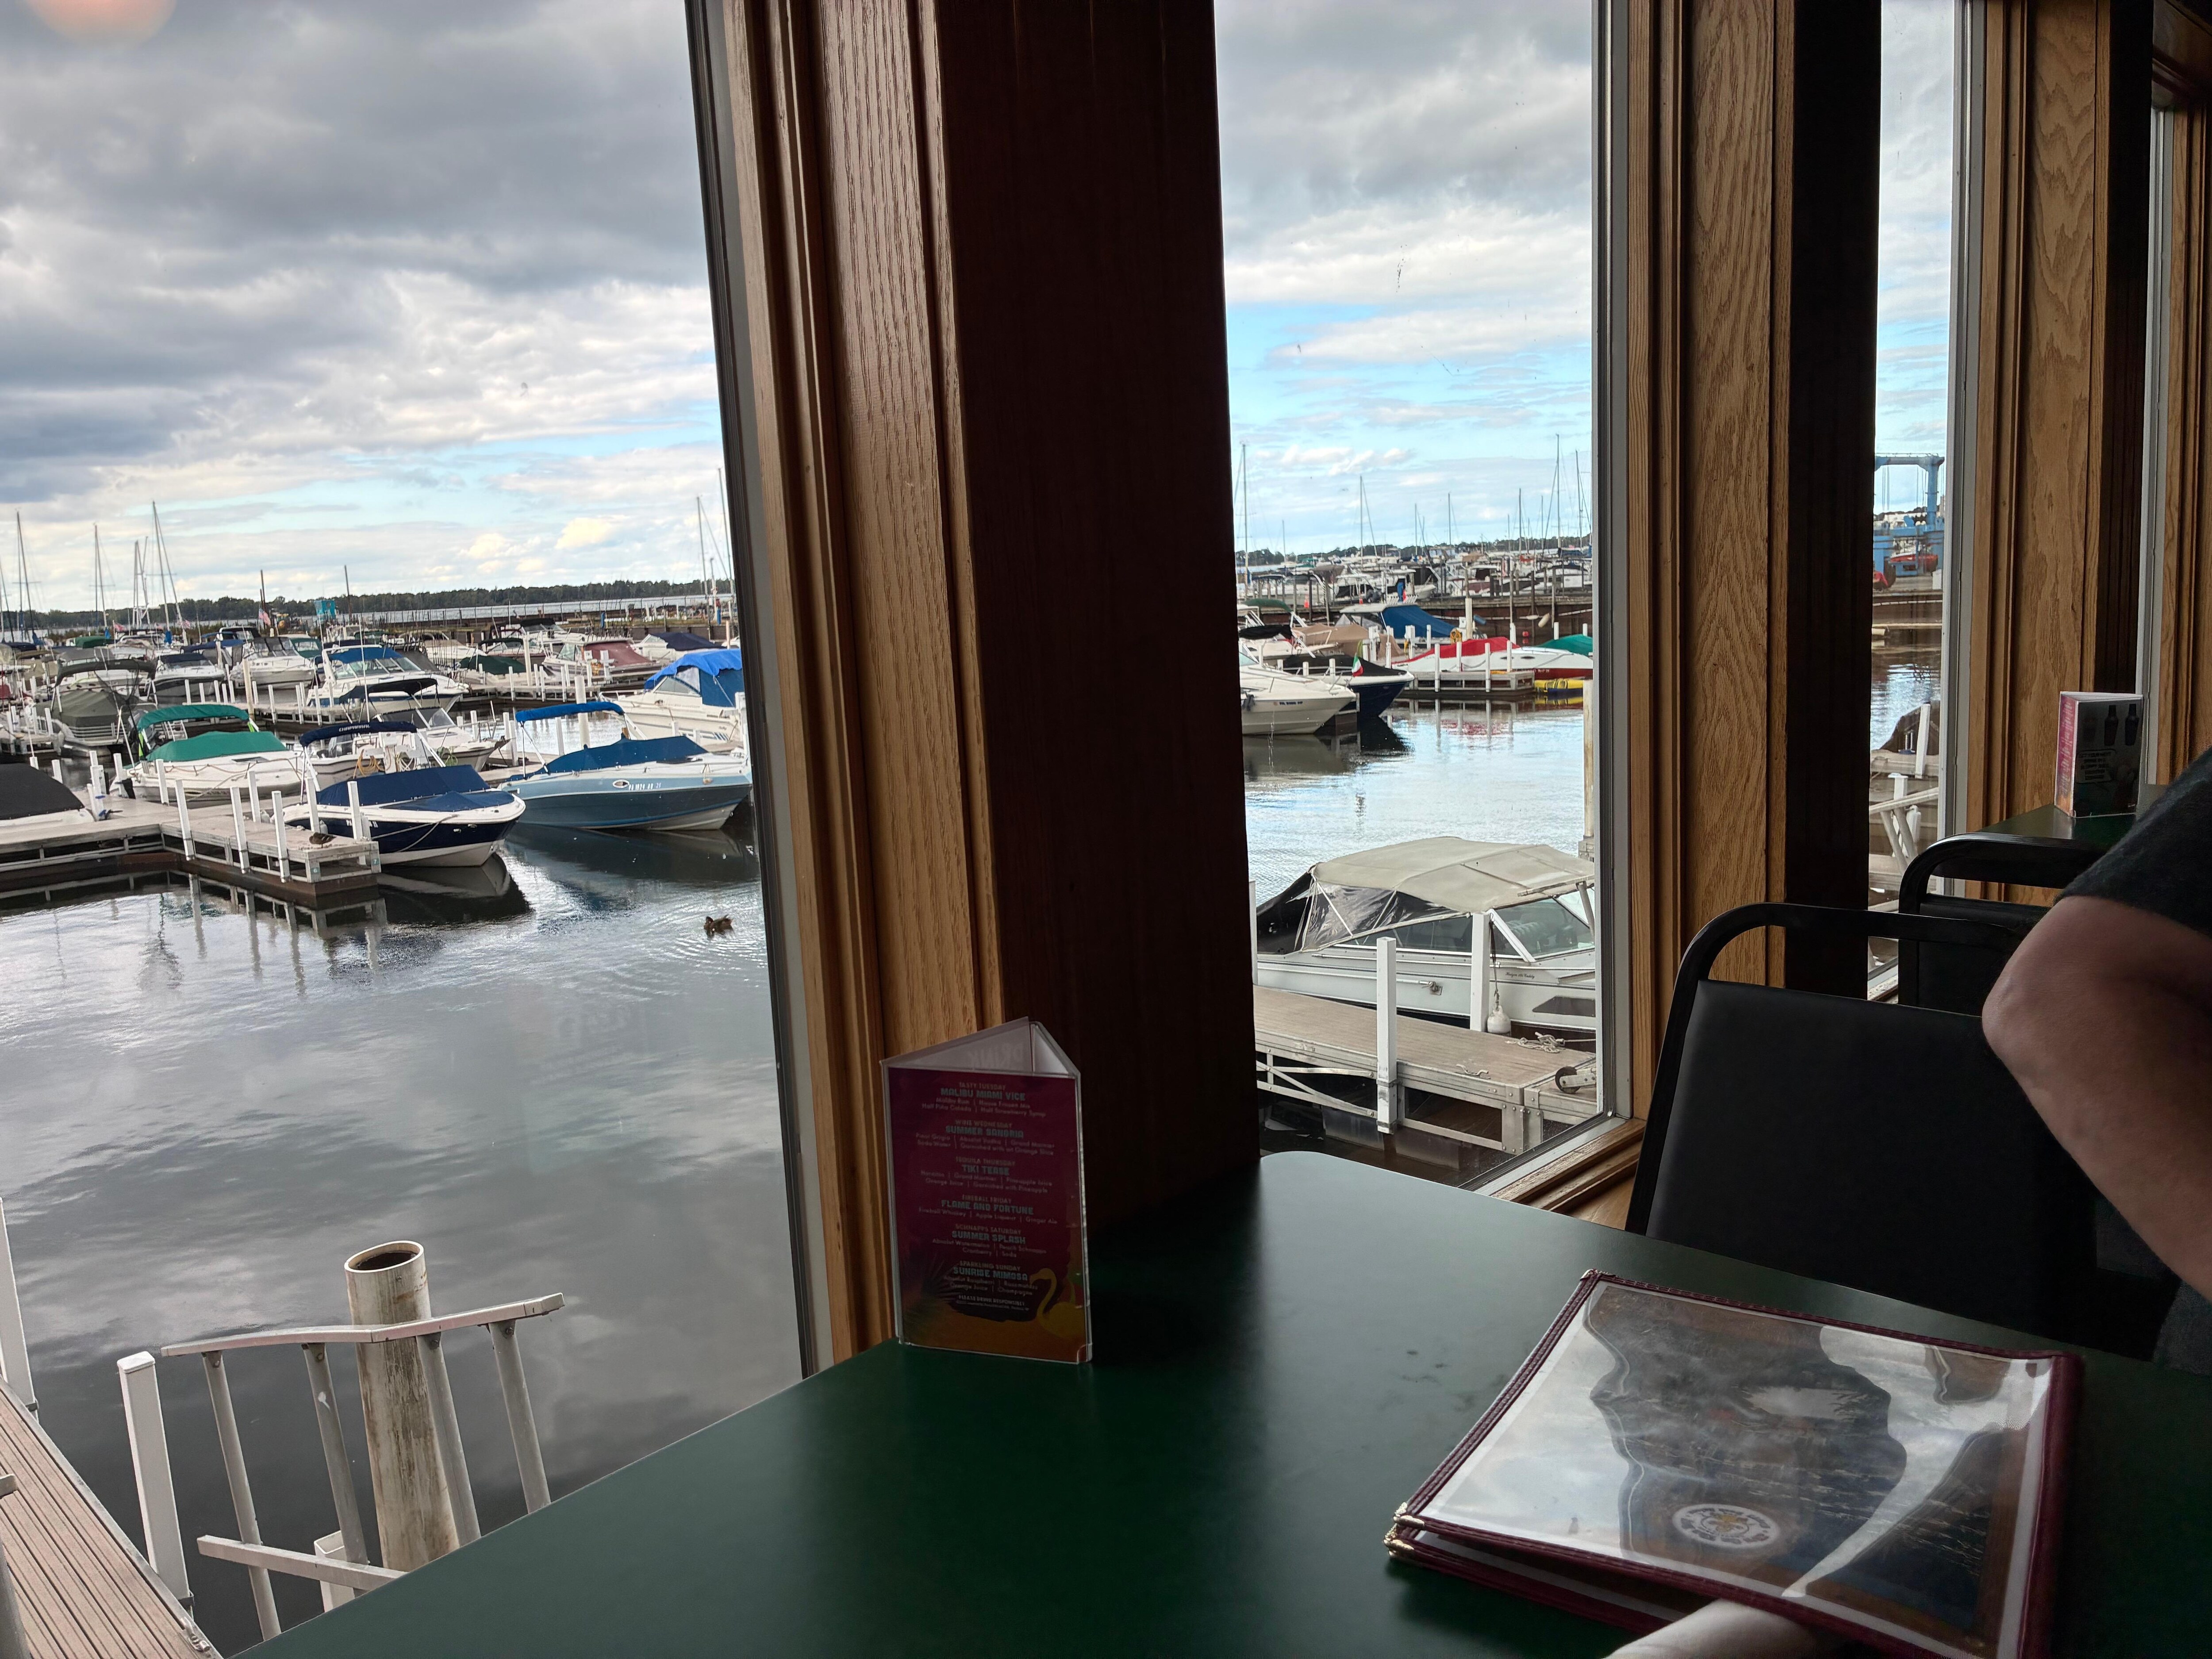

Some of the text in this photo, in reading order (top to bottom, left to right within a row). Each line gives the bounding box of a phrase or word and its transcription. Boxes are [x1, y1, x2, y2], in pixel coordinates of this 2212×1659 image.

[941, 1087, 1025, 1101] MALIBU MIAMI VICE
[946, 1125, 1024, 1139] SUMMER SANGRIA
[956, 1156, 980, 1164] TEQUILA
[962, 1164, 1010, 1176] TIKI TEASE
[962, 1194, 987, 1202] FIREBALL
[941, 1199, 1034, 1215] FLAME AND FORTUNE
[955, 1224, 1022, 1235] SCHNAPPS SATURDAY
[952, 1230, 1025, 1244] SUMMER SPLASH
[962, 1247, 992, 1256] Cranberry
[959, 1260, 995, 1269] SPARKLING
[953, 1266, 1028, 1281] SUNRISE MIMOSA
